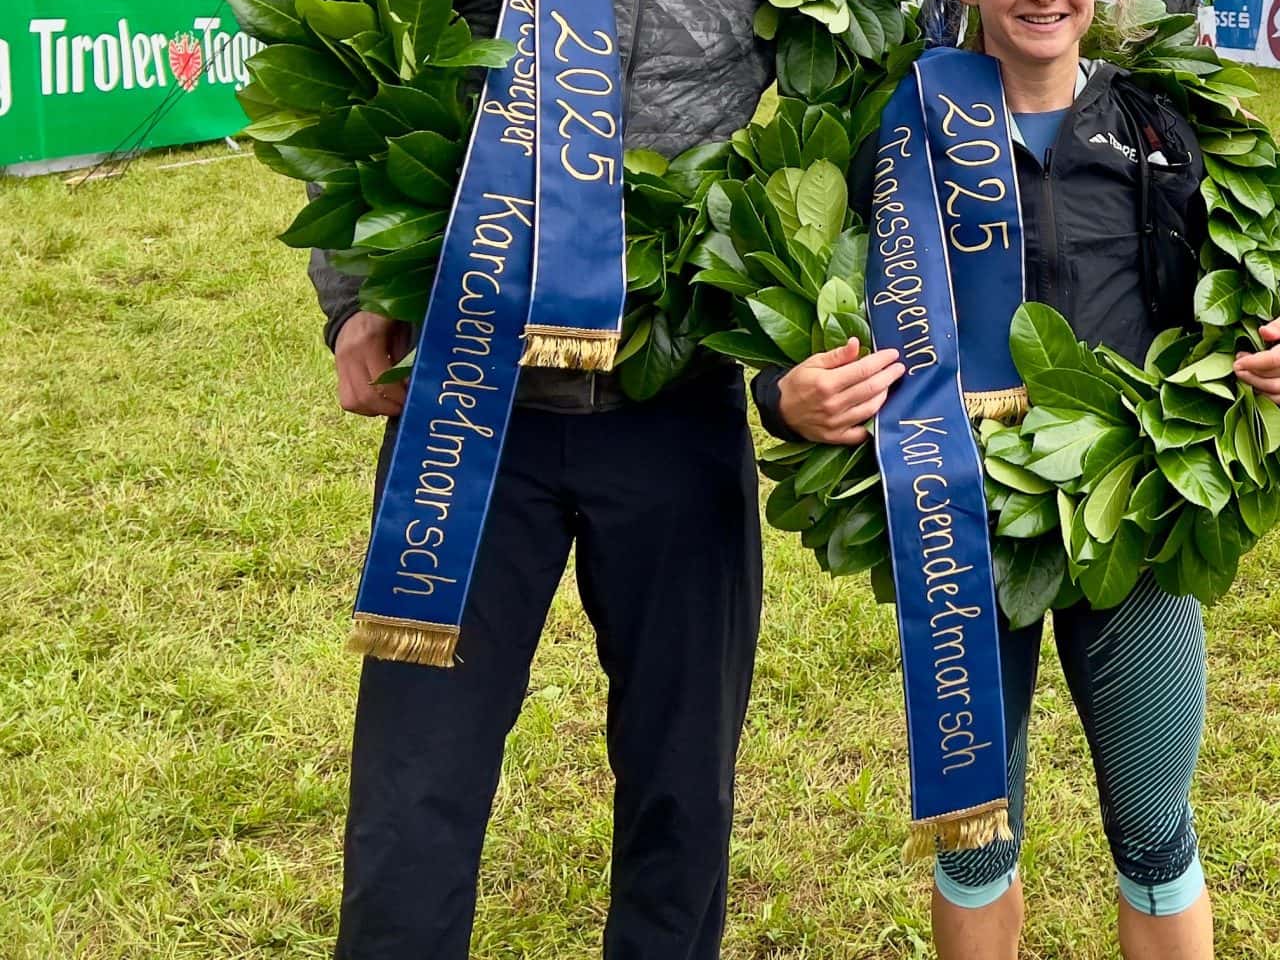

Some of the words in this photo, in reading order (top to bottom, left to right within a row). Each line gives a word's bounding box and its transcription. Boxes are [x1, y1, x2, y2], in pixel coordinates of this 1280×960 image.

[29, 18, 168, 95] Tiroler
[550, 10, 618, 186] 2025
[938, 94, 1010, 253] 2025
